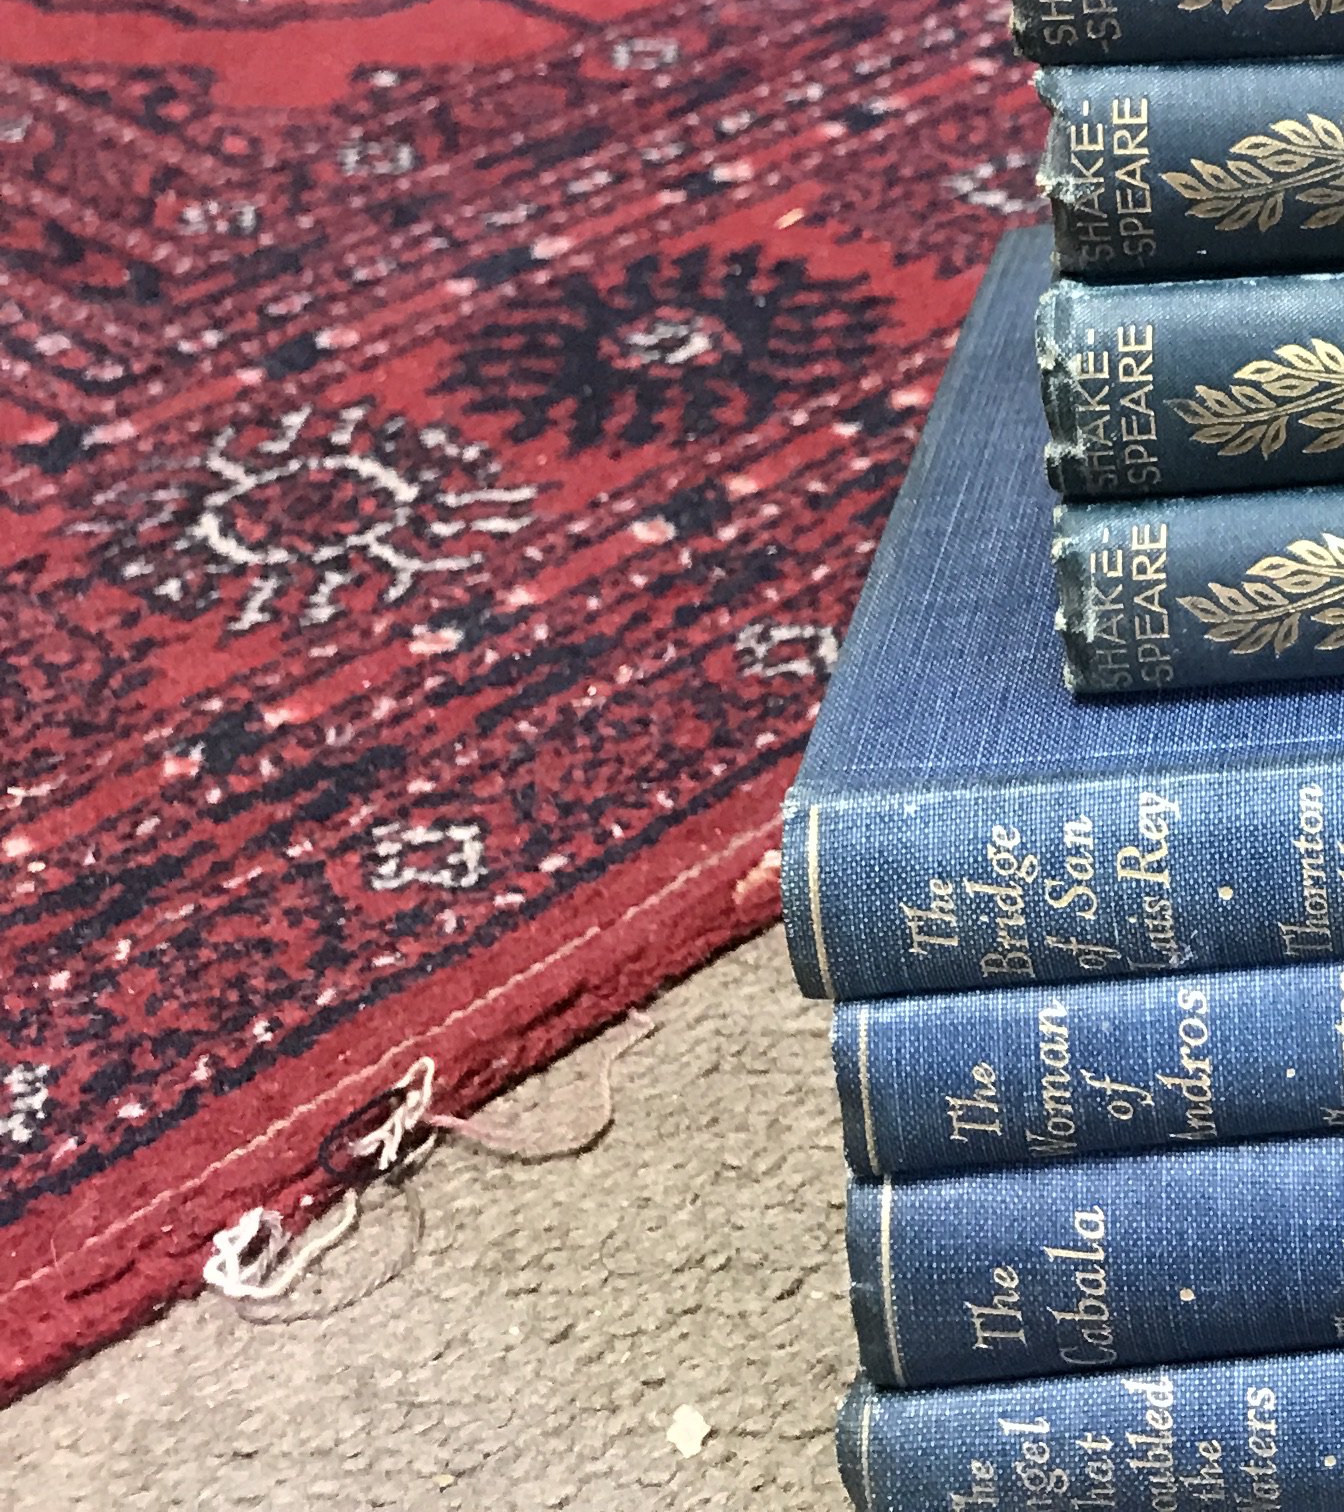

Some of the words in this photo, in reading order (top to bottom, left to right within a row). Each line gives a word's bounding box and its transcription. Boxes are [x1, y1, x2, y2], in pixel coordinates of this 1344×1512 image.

[1044, 815, 1097, 920] San
[1117, 790, 1181, 888] Rey
[1280, 782, 1333, 956] Thornton
[900, 879, 958, 955] The
[962, 825, 1039, 978] Bridge
[1127, 894, 1182, 971] Luis
[1045, 928, 1120, 971] of
[947, 1062, 1001, 1143] The
[1026, 997, 1077, 1157] Woman
[1081, 1069, 1156, 1120] of
[964, 1266, 1027, 1349] The
[1043, 1204, 1118, 1365] Cabala
[1122, 1373, 1176, 1512] oubled
[1180, 1437, 1223, 1502] the
